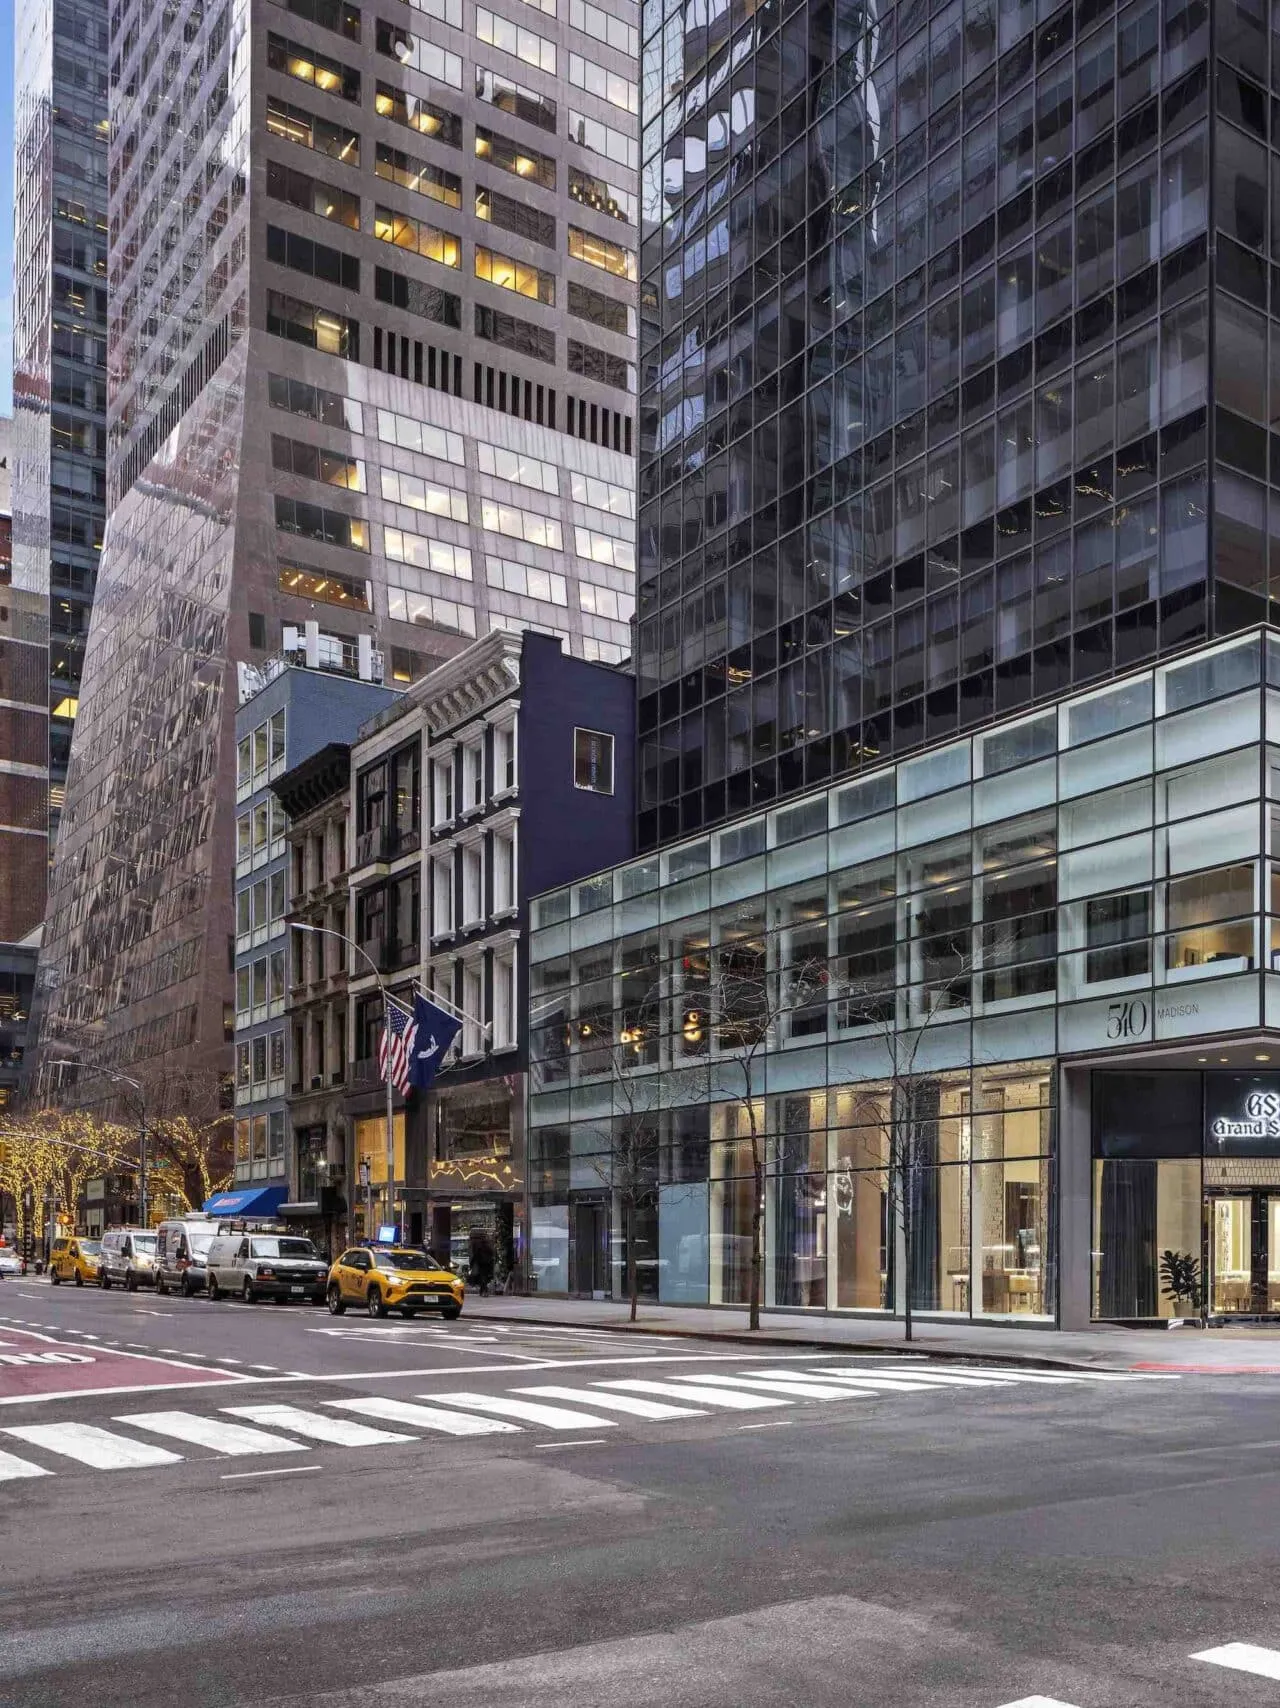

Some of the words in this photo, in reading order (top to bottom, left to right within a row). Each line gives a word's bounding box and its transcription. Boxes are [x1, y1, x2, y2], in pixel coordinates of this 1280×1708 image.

[1107, 999, 1148, 1040] 540
[1157, 1002, 1200, 1020] MADISON
[1246, 1092, 1279, 1117] GS
[1212, 1118, 1263, 1136] Grand
